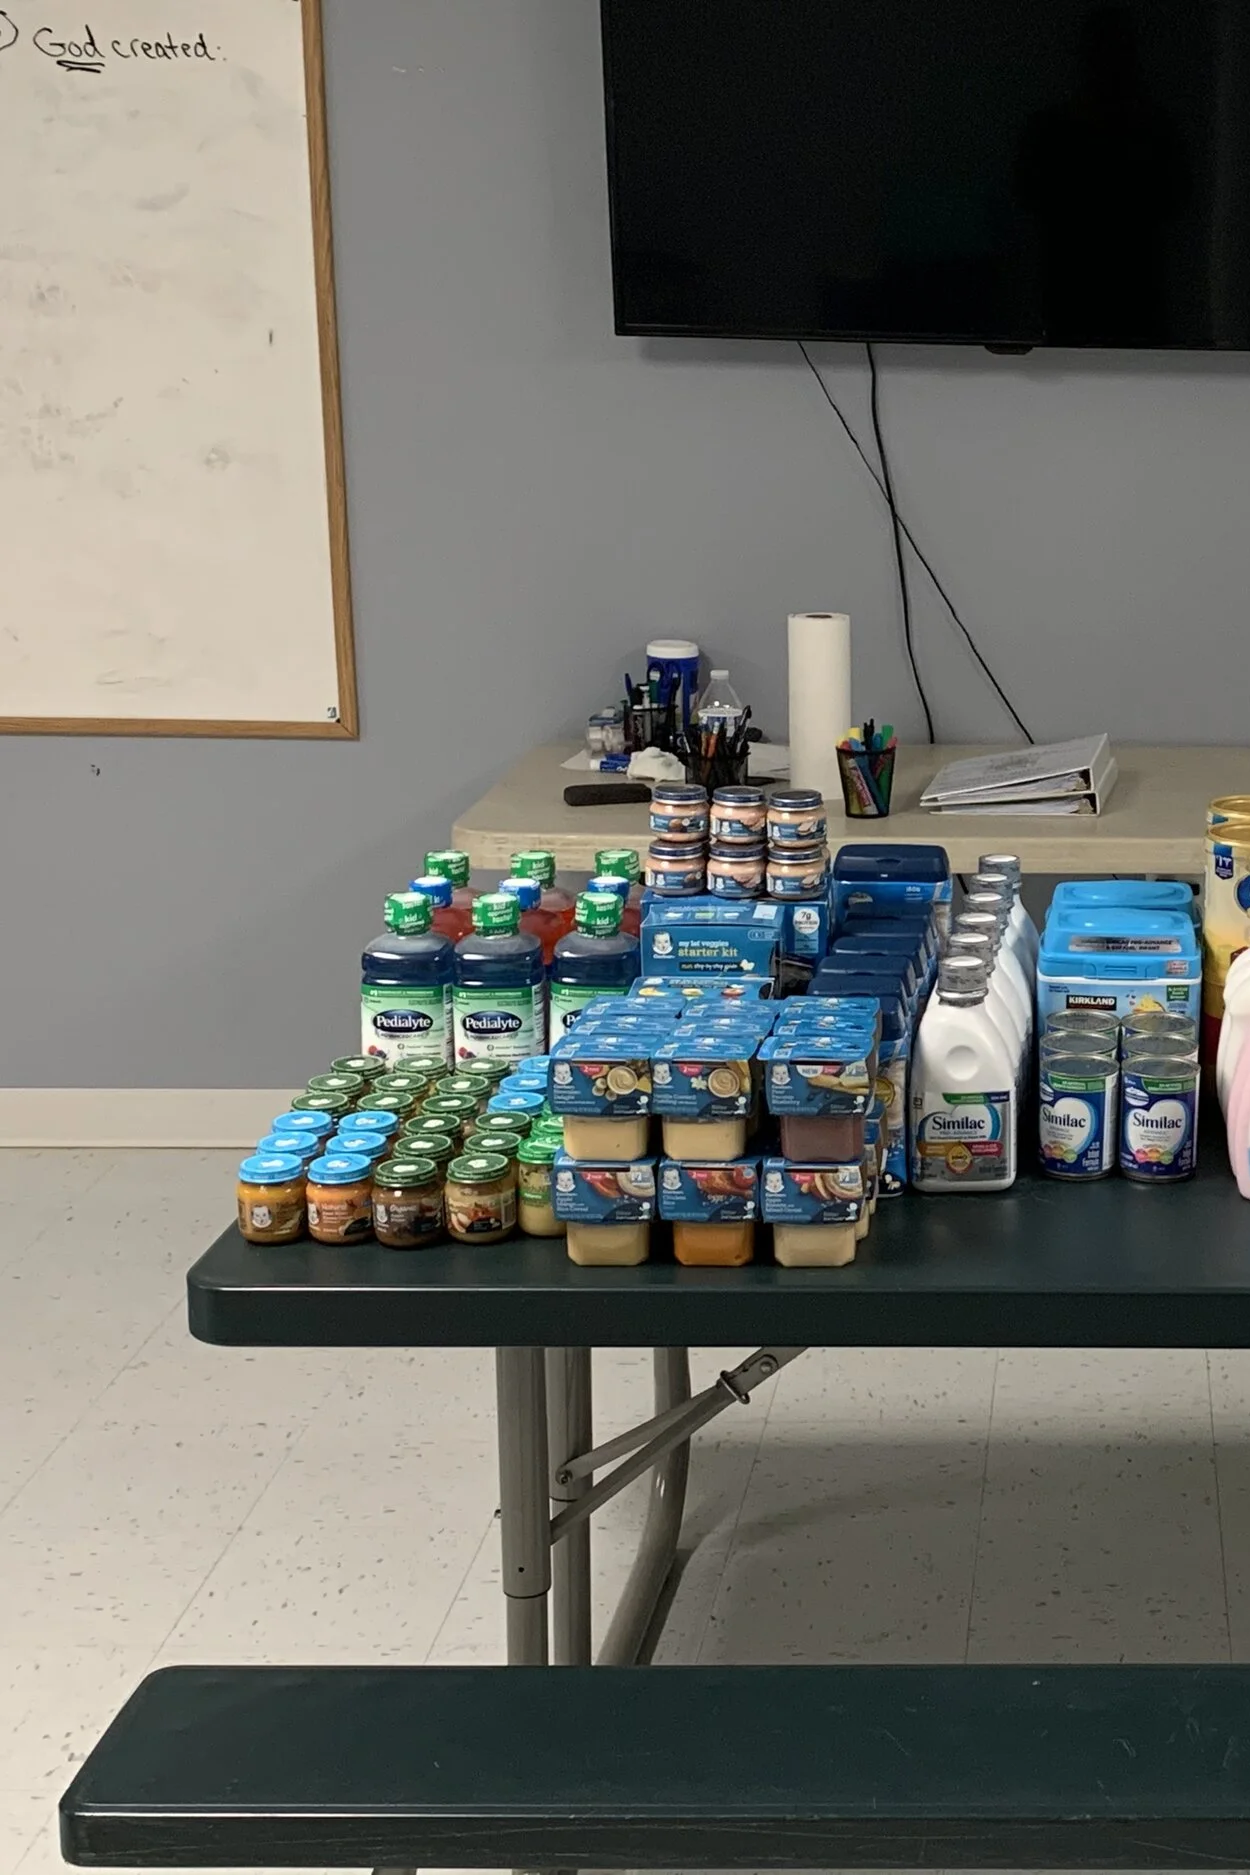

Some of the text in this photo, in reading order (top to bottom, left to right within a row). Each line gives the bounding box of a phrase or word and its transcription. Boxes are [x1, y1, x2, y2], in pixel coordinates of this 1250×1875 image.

[32, 24, 105, 59] God
[678, 946, 738, 957] starter kit
[1068, 996, 1116, 1006] KIRKLAND
[376, 1015, 432, 1029] Pedialyte
[465, 1016, 520, 1030] Pedialyte
[931, 1115, 986, 1131] Similac
[1042, 1106, 1087, 1128] Similac
[1132, 1112, 1183, 1129] Similac
